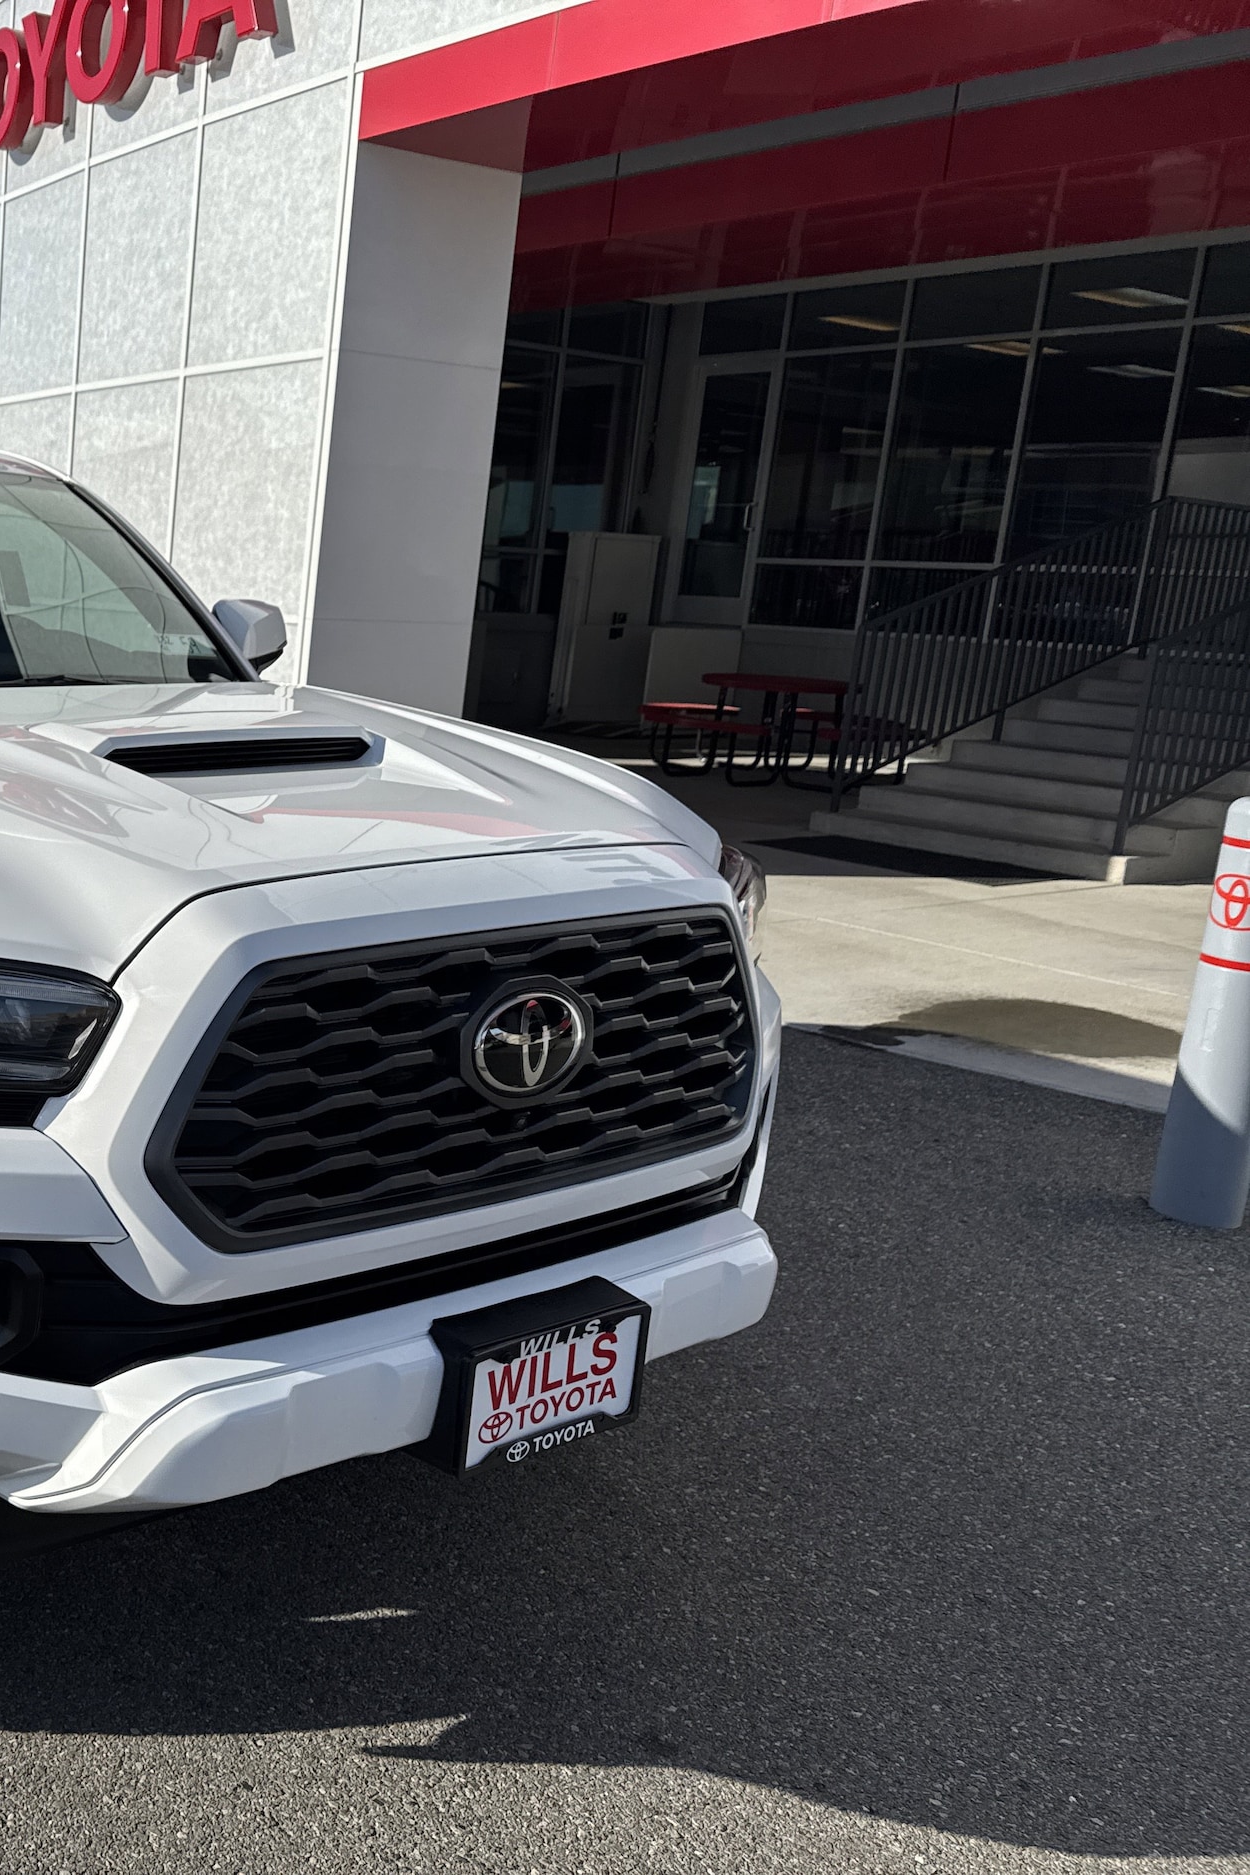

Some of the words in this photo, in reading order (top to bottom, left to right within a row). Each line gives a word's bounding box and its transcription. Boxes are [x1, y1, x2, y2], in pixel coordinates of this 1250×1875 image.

[520, 1319, 601, 1358] WILLS
[487, 1332, 618, 1411] WILLS
[515, 1377, 617, 1430] TOYOTA
[533, 1419, 595, 1453] TOYOTA
